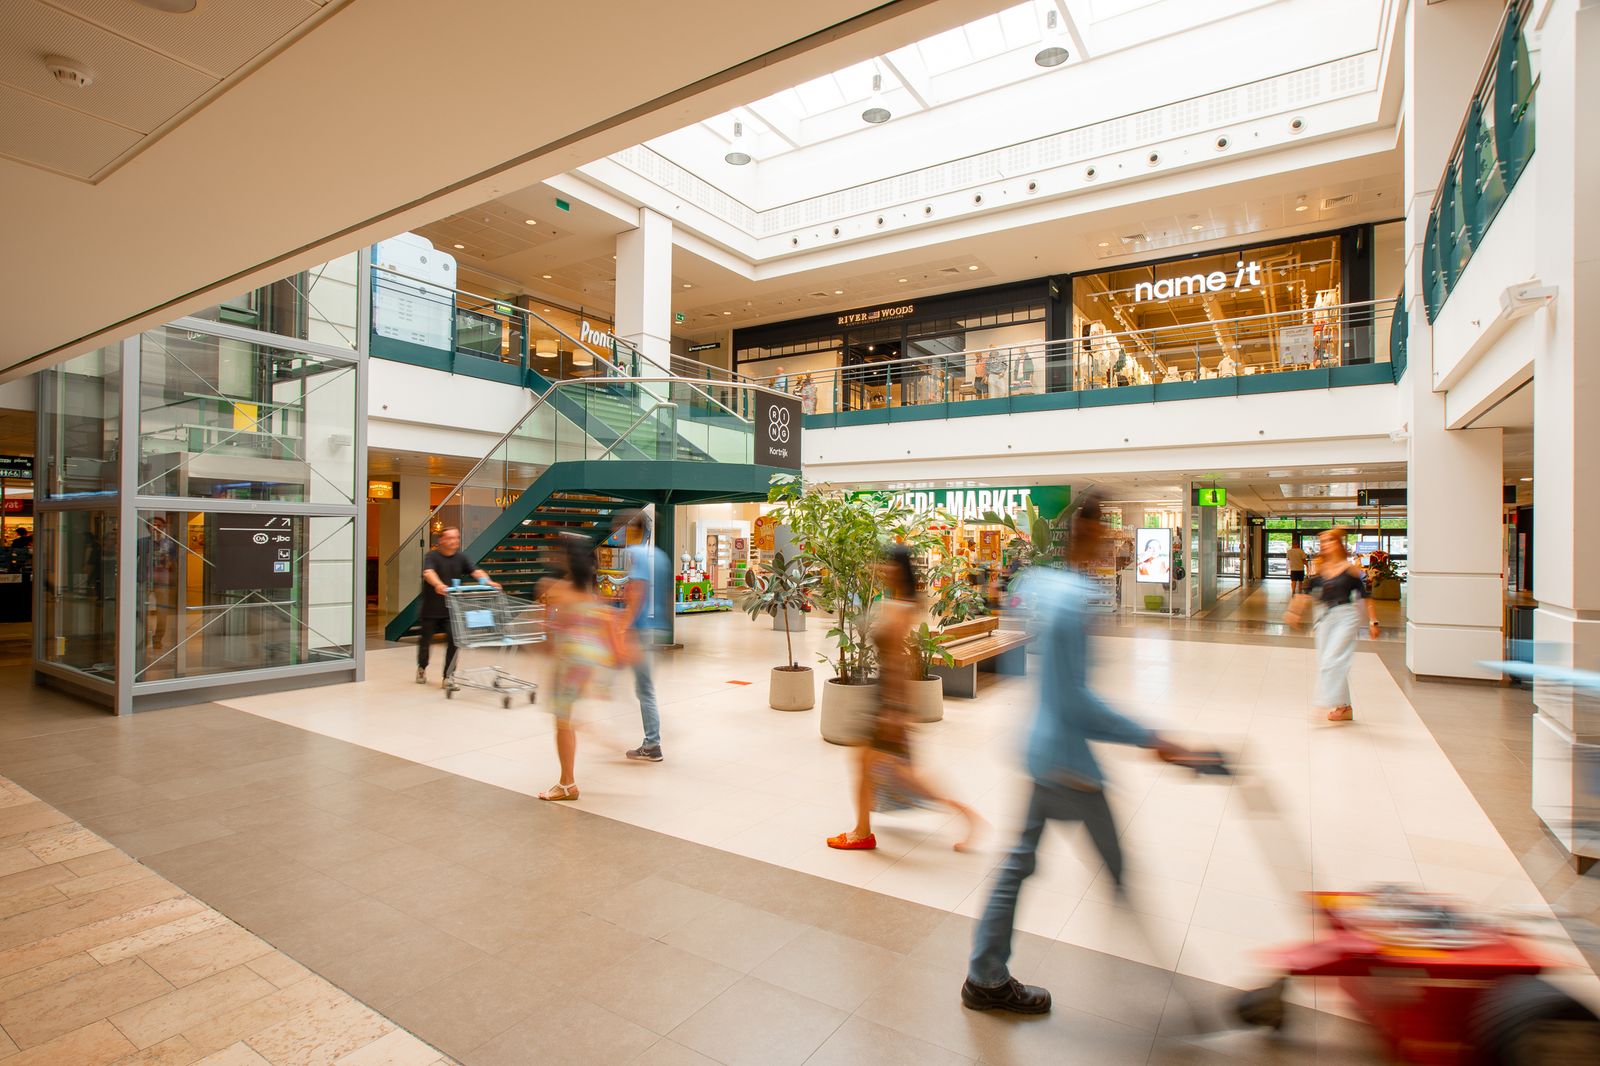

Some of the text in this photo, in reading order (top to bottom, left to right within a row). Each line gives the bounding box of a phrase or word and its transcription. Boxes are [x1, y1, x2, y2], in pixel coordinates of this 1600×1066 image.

[1135, 261, 1260, 302] name it
[837, 305, 914, 325] RIVER WOODS
[769, 446, 788, 459] Kortrijk
